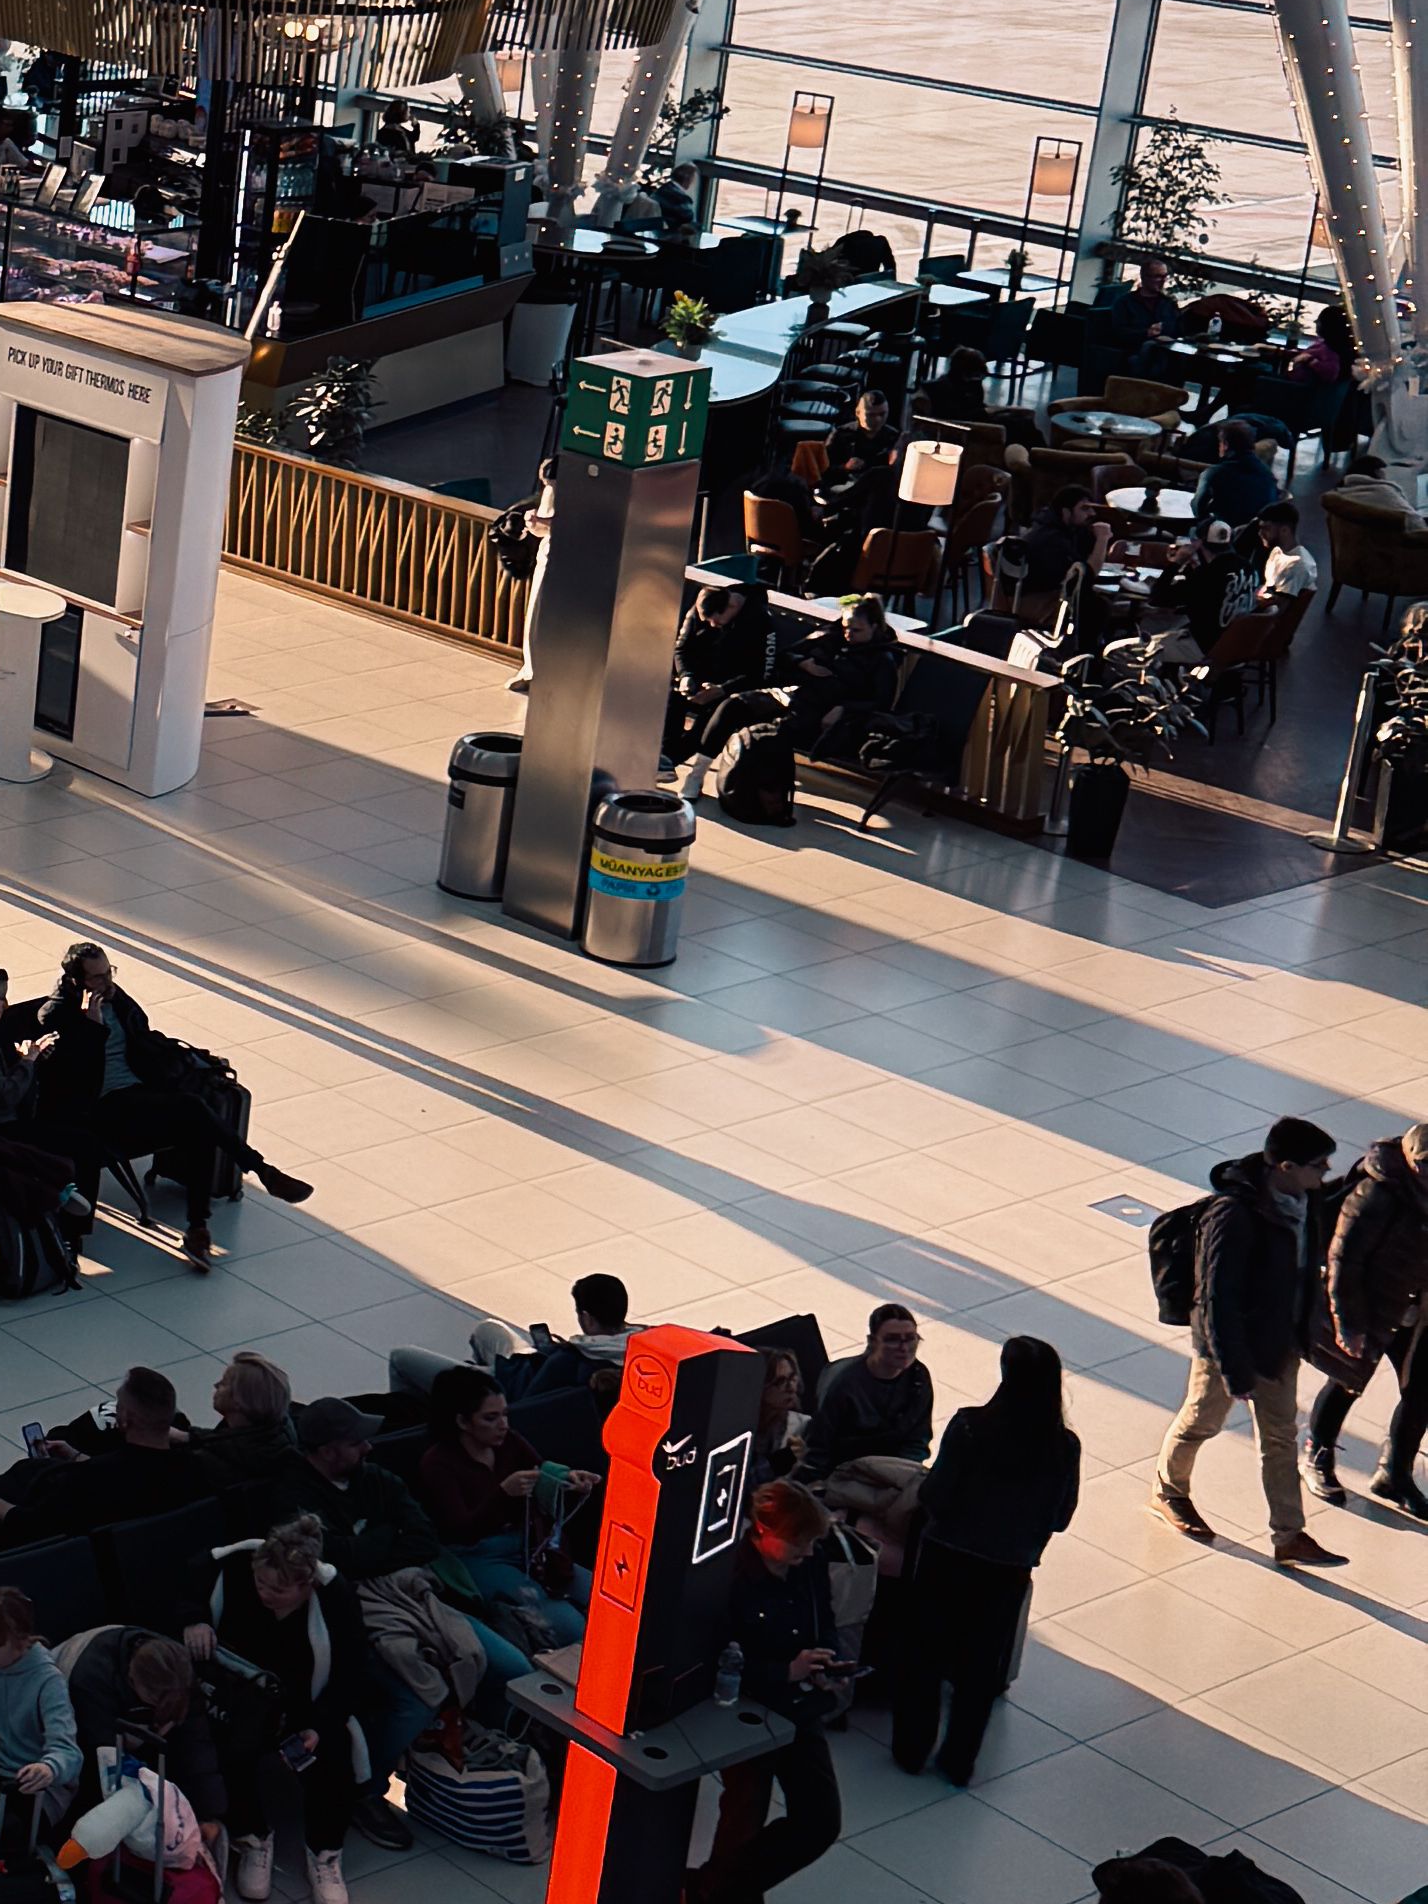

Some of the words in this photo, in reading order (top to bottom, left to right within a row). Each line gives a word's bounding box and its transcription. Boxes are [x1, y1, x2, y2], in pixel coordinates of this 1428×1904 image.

[7, 346, 28, 366] PICK
[28, 352, 41, 370] UP
[42, 357, 64, 377] YOUR
[65, 364, 85, 384] GIFT
[85, 369, 126, 396] THERMOS
[127, 382, 153, 404] HERE
[637, 1377, 663, 1398] bud
[666, 1446, 697, 1470] bud
